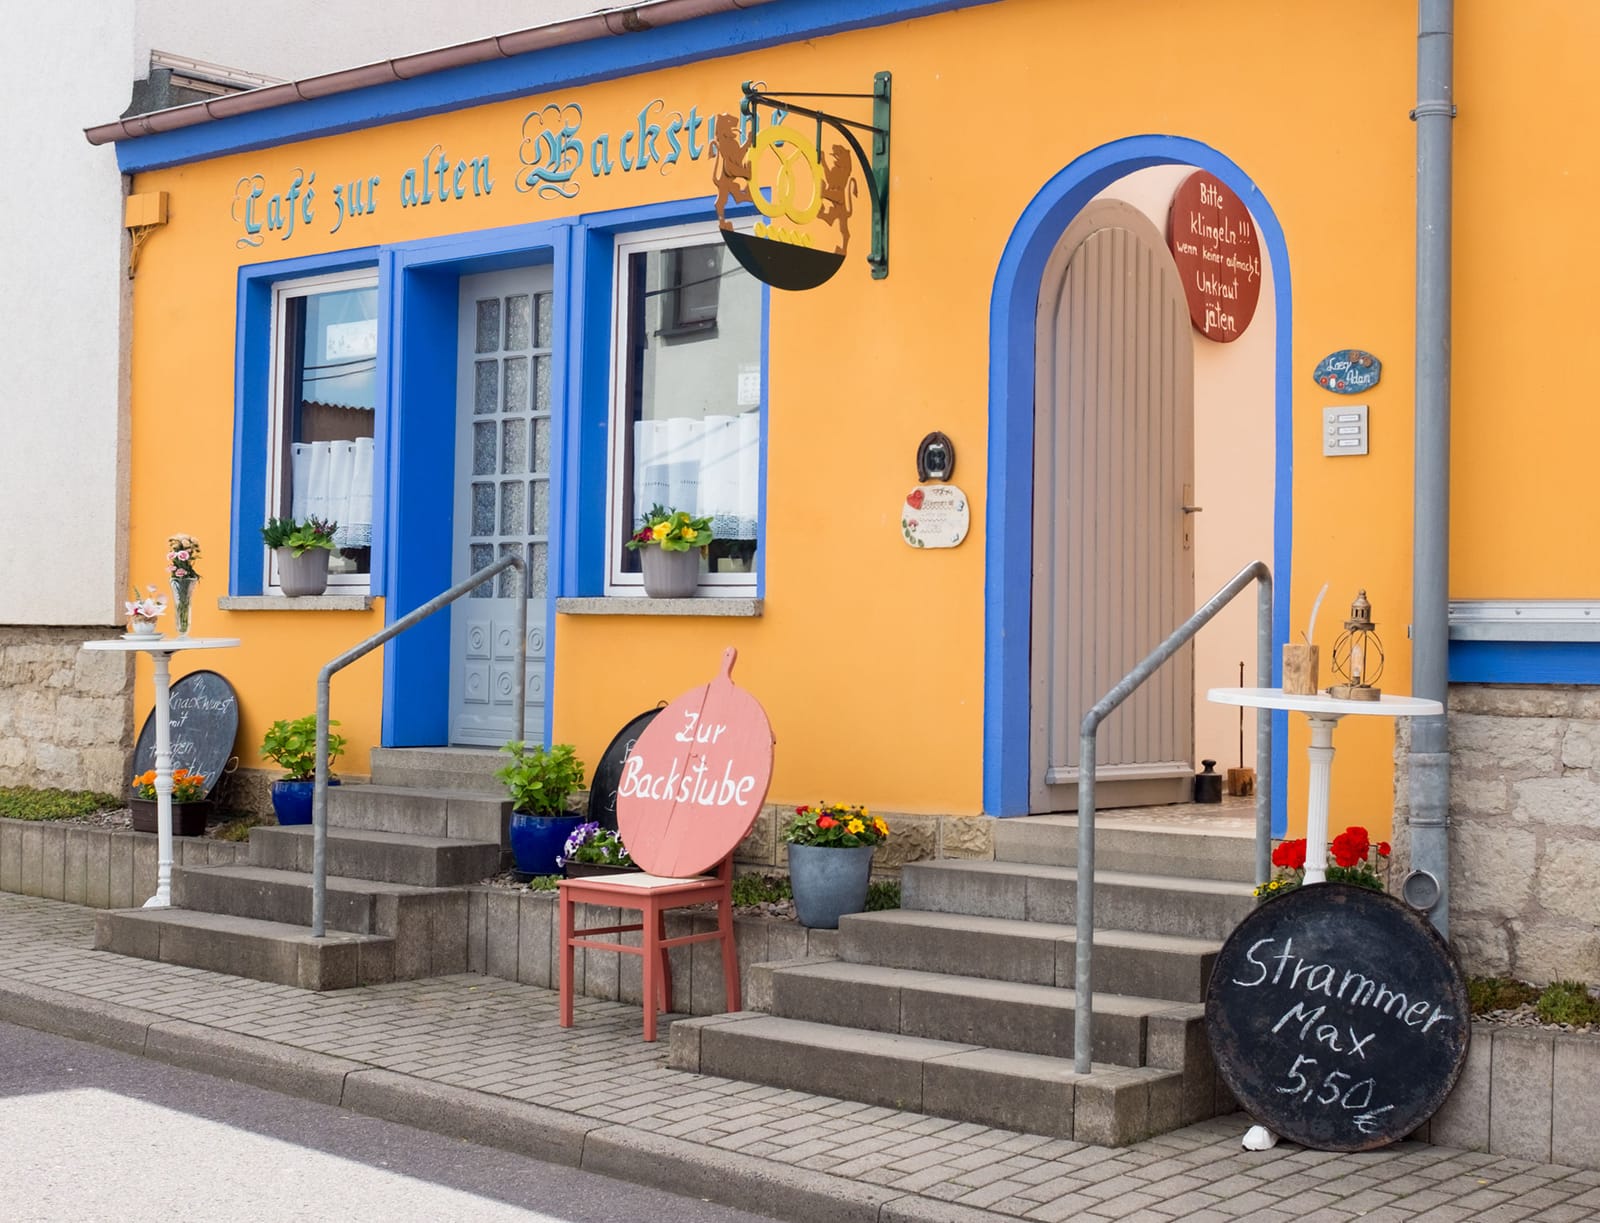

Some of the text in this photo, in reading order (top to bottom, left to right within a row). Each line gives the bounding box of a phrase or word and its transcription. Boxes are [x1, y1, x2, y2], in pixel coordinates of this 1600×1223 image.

[231, 167, 317, 249] Café
[330, 175, 381, 234] zur
[400, 144, 495, 208] alten
[1199, 182, 1224, 210] Bitte
[1176, 240, 1198, 256] wenn
[1202, 245, 1224, 264] keiner
[1196, 270, 1239, 300] Unkraut
[1203, 302, 1237, 333] jäten
[674, 709, 727, 744] Zur
[617, 754, 755, 806] Backstube
[1232, 937, 1454, 1034] Strammer
[1271, 1001, 1376, 1060] Max
[1275, 1054, 1377, 1109] 5,50
